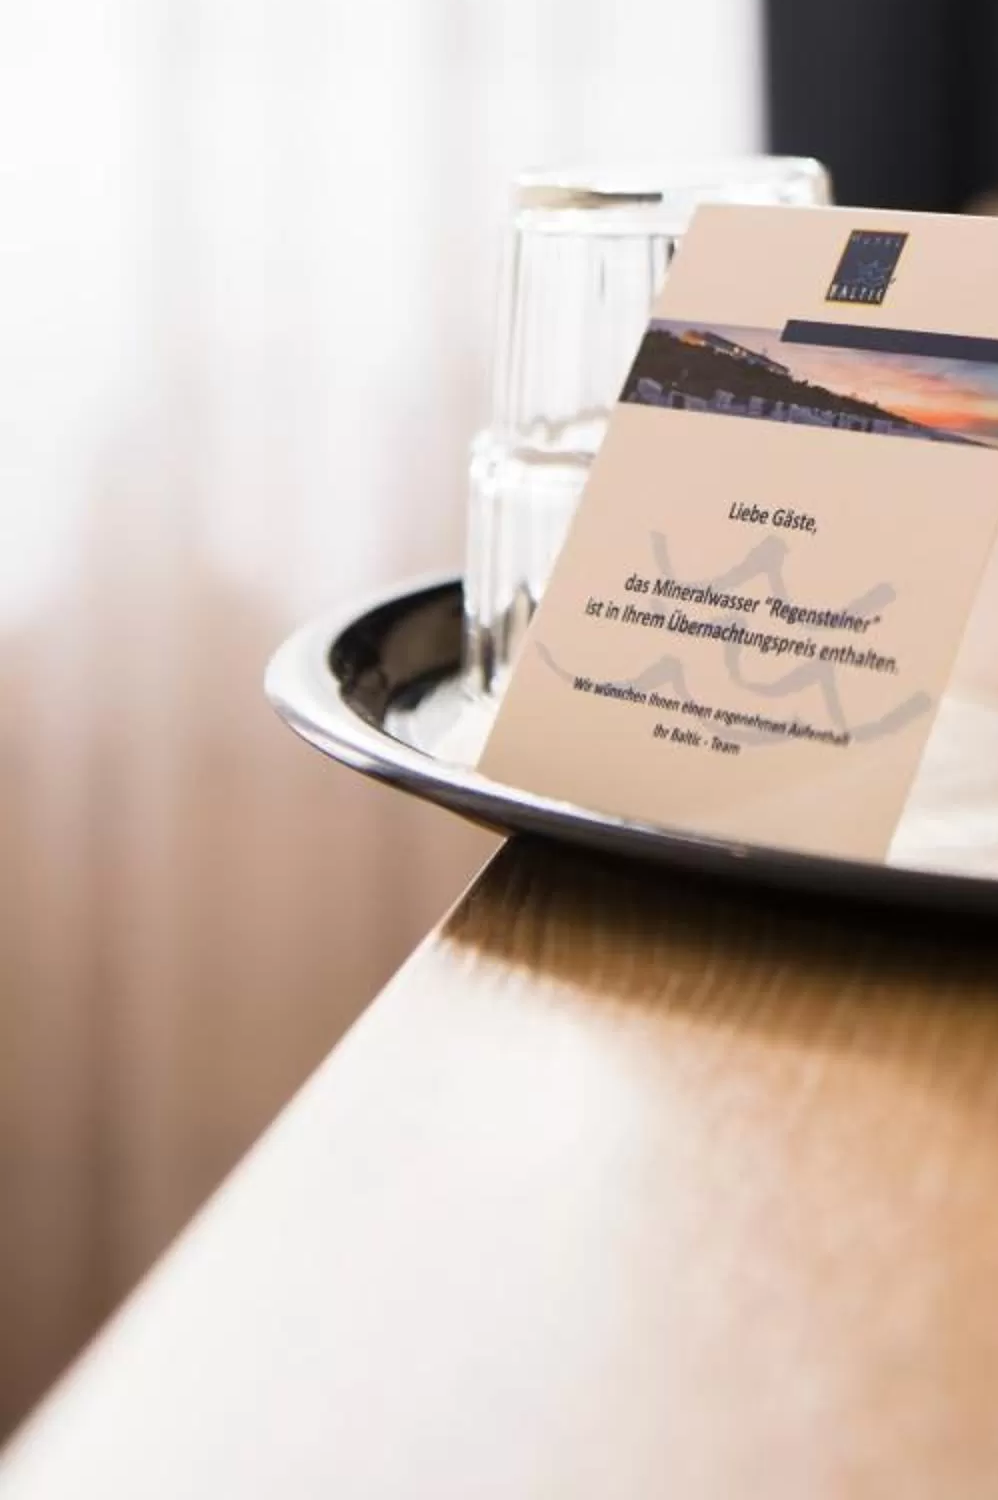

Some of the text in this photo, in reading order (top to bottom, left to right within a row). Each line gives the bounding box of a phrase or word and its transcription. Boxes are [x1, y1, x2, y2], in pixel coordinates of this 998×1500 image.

[728, 501, 817, 534] Liebe Gäste,
[624, 573, 650, 593] das
[651, 579, 760, 613] Mineralwasser
[585, 597, 898, 676] ist in Ihrem Übernachtungspreis enthalten.
[573, 676, 593, 692] Wir
[594, 682, 647, 704] wünschen
[648, 692, 680, 712] Ihnen
[681, 700, 713, 719] einen
[713, 708, 787, 734] angenehmen
[653, 723, 669, 739] Ihr
[670, 727, 701, 747] Baltic
[711, 735, 741, 756] Team
